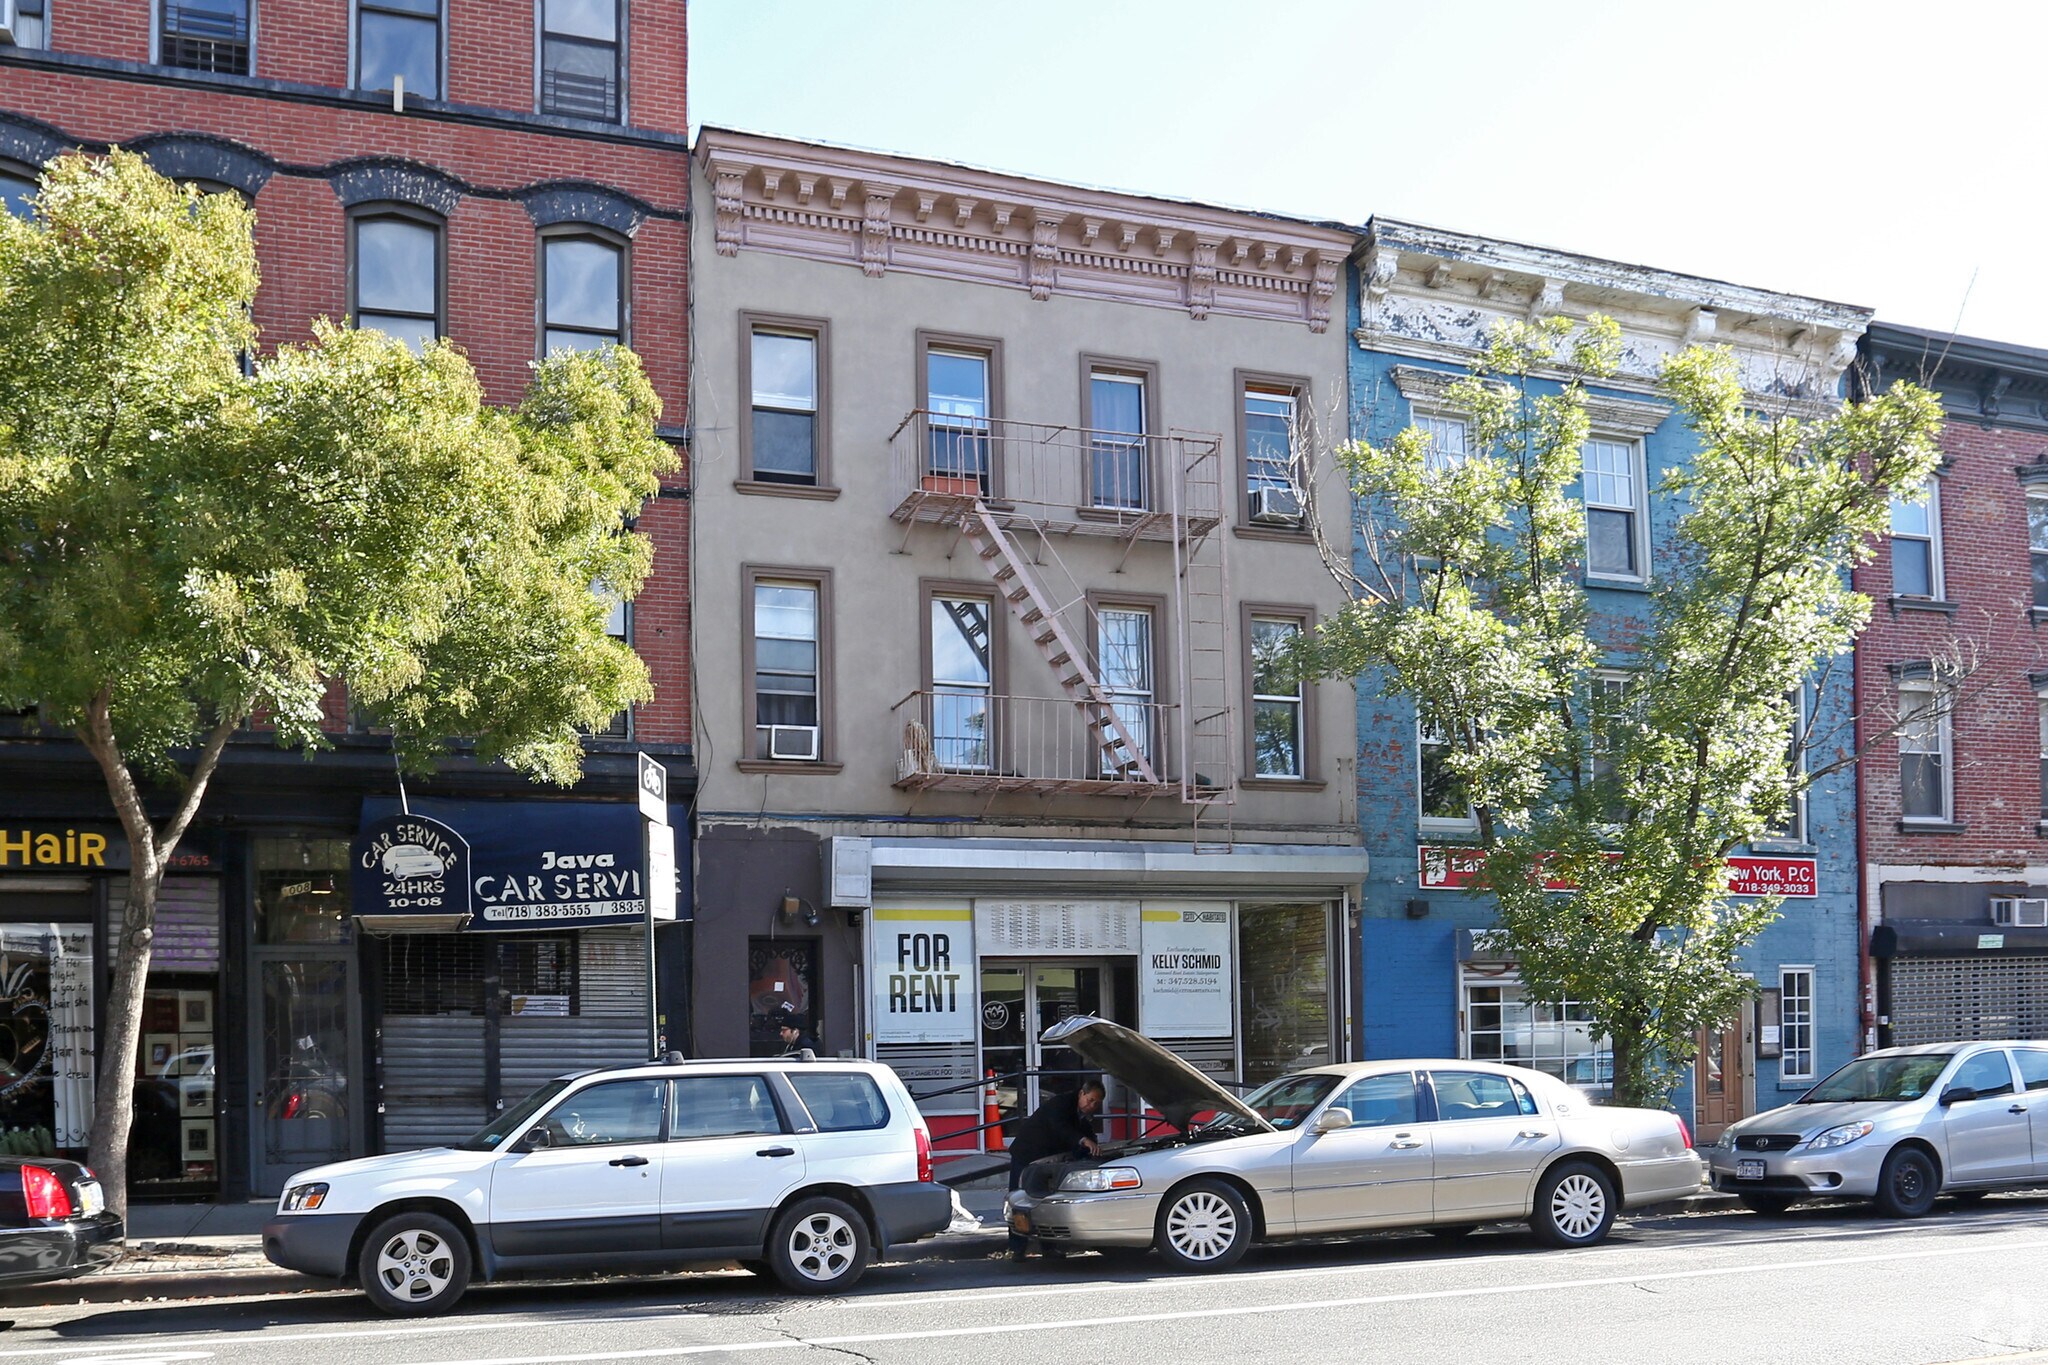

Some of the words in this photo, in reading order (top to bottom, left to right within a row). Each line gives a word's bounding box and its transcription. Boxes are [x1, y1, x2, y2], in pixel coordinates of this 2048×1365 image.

[362, 833, 393, 868] CAR
[396, 824, 457, 870] SERVICE
[541, 851, 615, 870] Java
[1752, 866, 1784, 883] York,
[1788, 867, 1814, 882] P.C.
[382, 880, 445, 894] 24HRS
[474, 874, 546, 902] CAR
[553, 868, 681, 900] SERVI
[1738, 883, 1809, 893] 718-349-3033
[388, 897, 442, 907] 10-08
[535, 903, 591, 917] 383-5555
[898, 933, 950, 972] FOR
[1152, 955, 1180, 969] KELLY
[1182, 955, 1221, 969] SCHMID
[889, 974, 960, 1013] RENT
